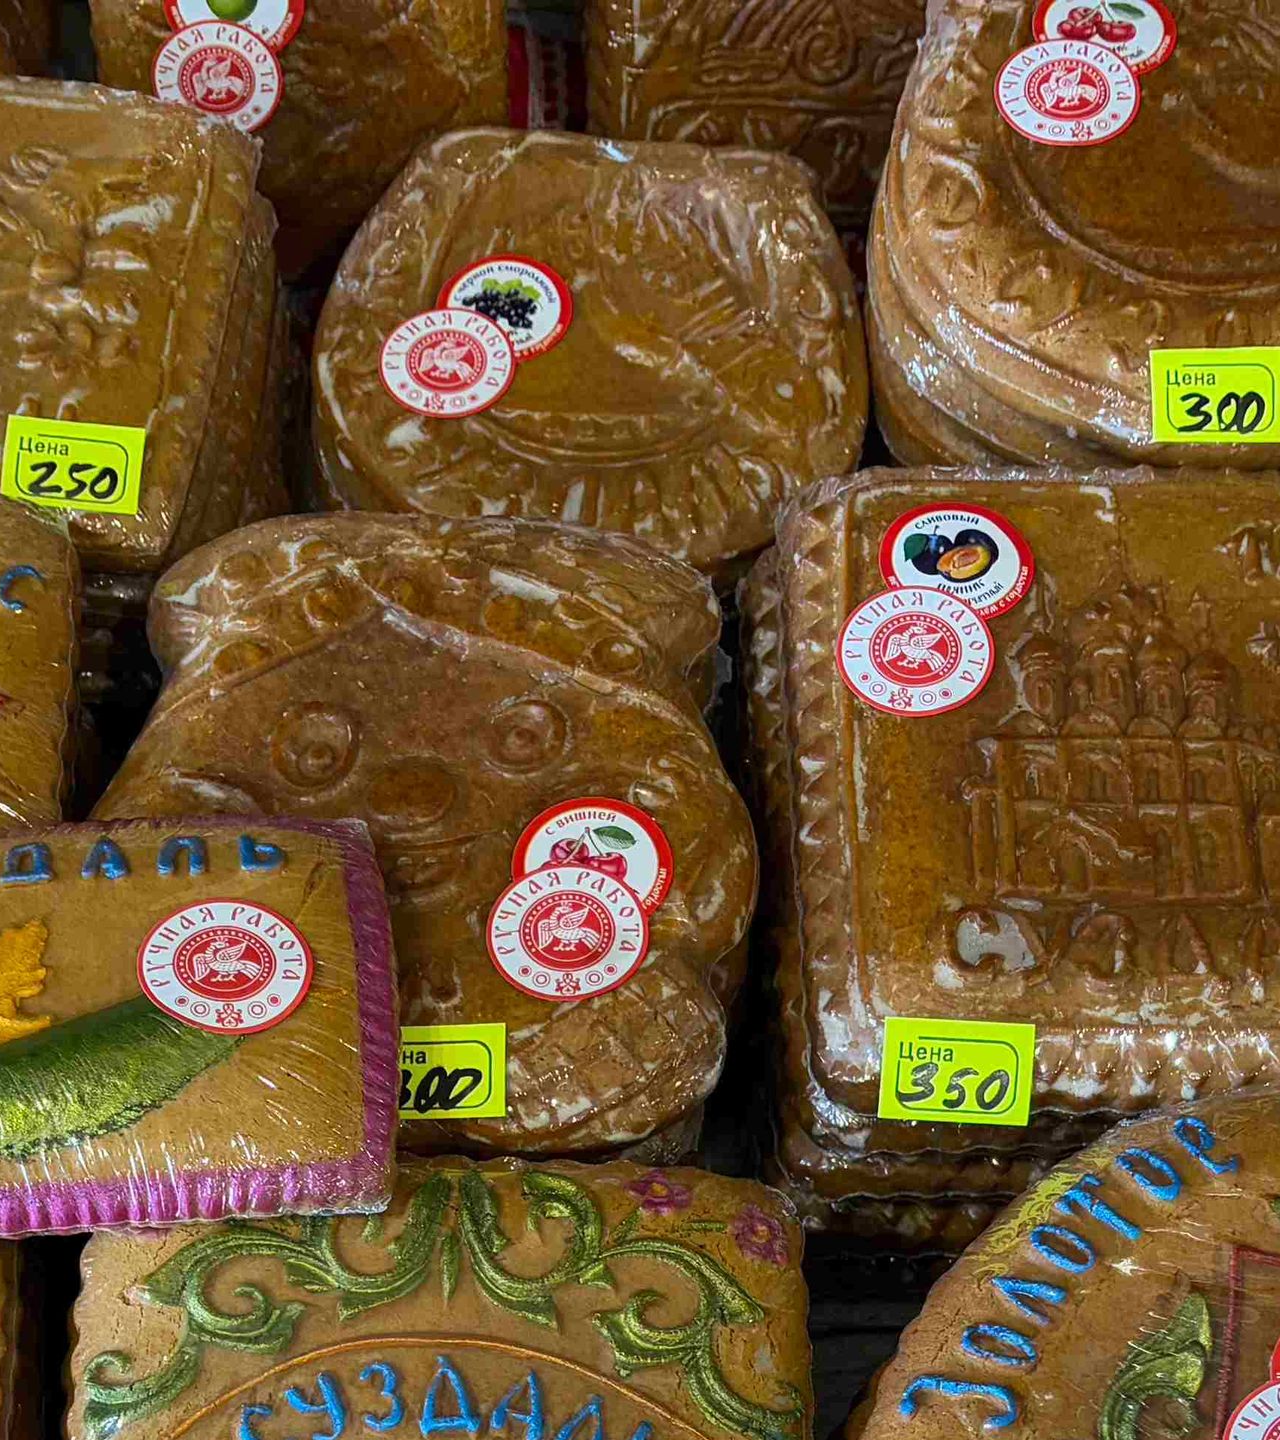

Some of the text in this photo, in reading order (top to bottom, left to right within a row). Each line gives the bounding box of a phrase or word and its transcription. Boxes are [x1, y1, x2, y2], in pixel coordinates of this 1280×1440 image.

[158, 27, 202, 93] УЧНАЯ
[1166, 368, 1217, 388] Цена
[1177, 391, 1265, 433] 300
[19, 435, 70, 456] Цена
[29, 462, 120, 498] 250
[844, 590, 986, 687] РУЧНАЯ РАБОТА
[496, 871, 641, 956] РУЧНАЯ РАБОТА
[151, 905, 300, 988] РУЧНАЯ РАБОТА
[402, 1048, 427, 1066] на
[898, 1040, 955, 1063] Цена
[895, 1062, 1010, 1112] 350
